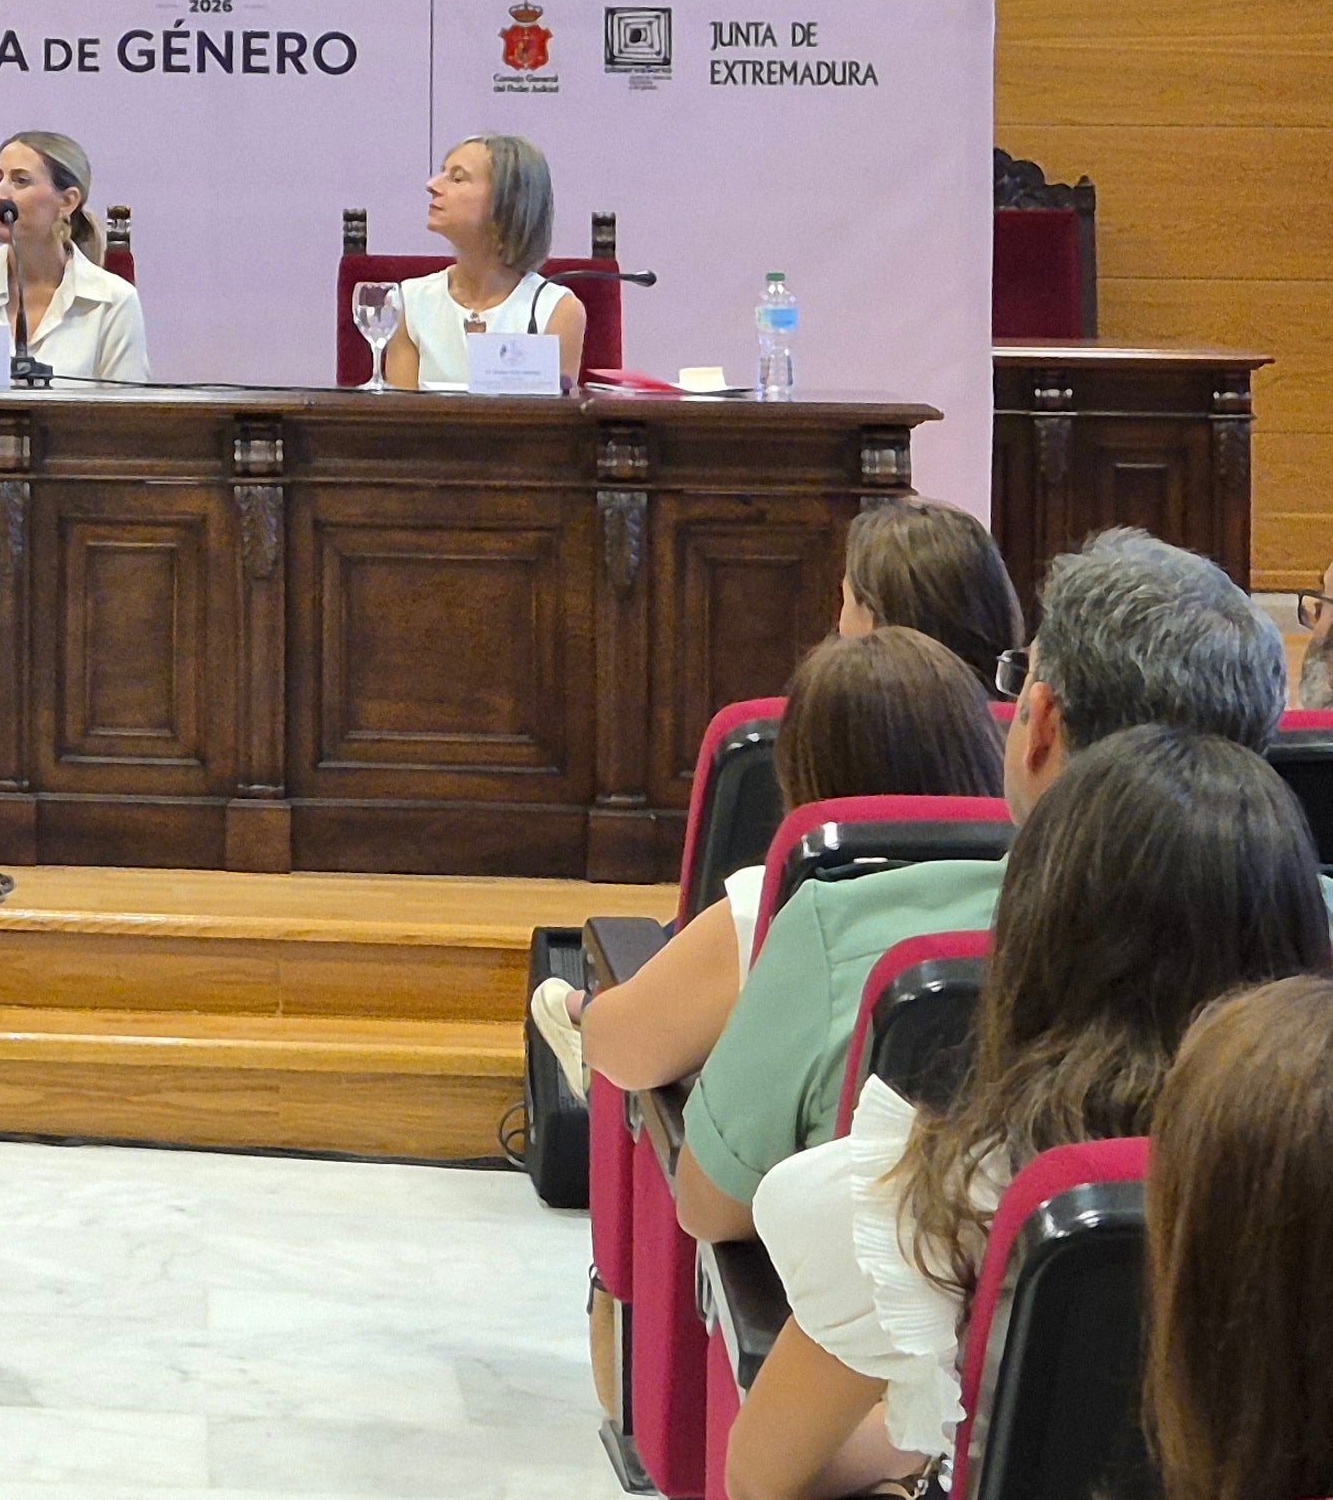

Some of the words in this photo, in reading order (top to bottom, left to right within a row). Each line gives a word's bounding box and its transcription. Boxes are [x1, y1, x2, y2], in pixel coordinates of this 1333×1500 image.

[43, 38, 100, 73] DE
[117, 18, 358, 75] GÉNERO
[709, 21, 778, 51] JUNTA
[791, 21, 819, 47] DE
[709, 59, 879, 87] EXTREMADURA
